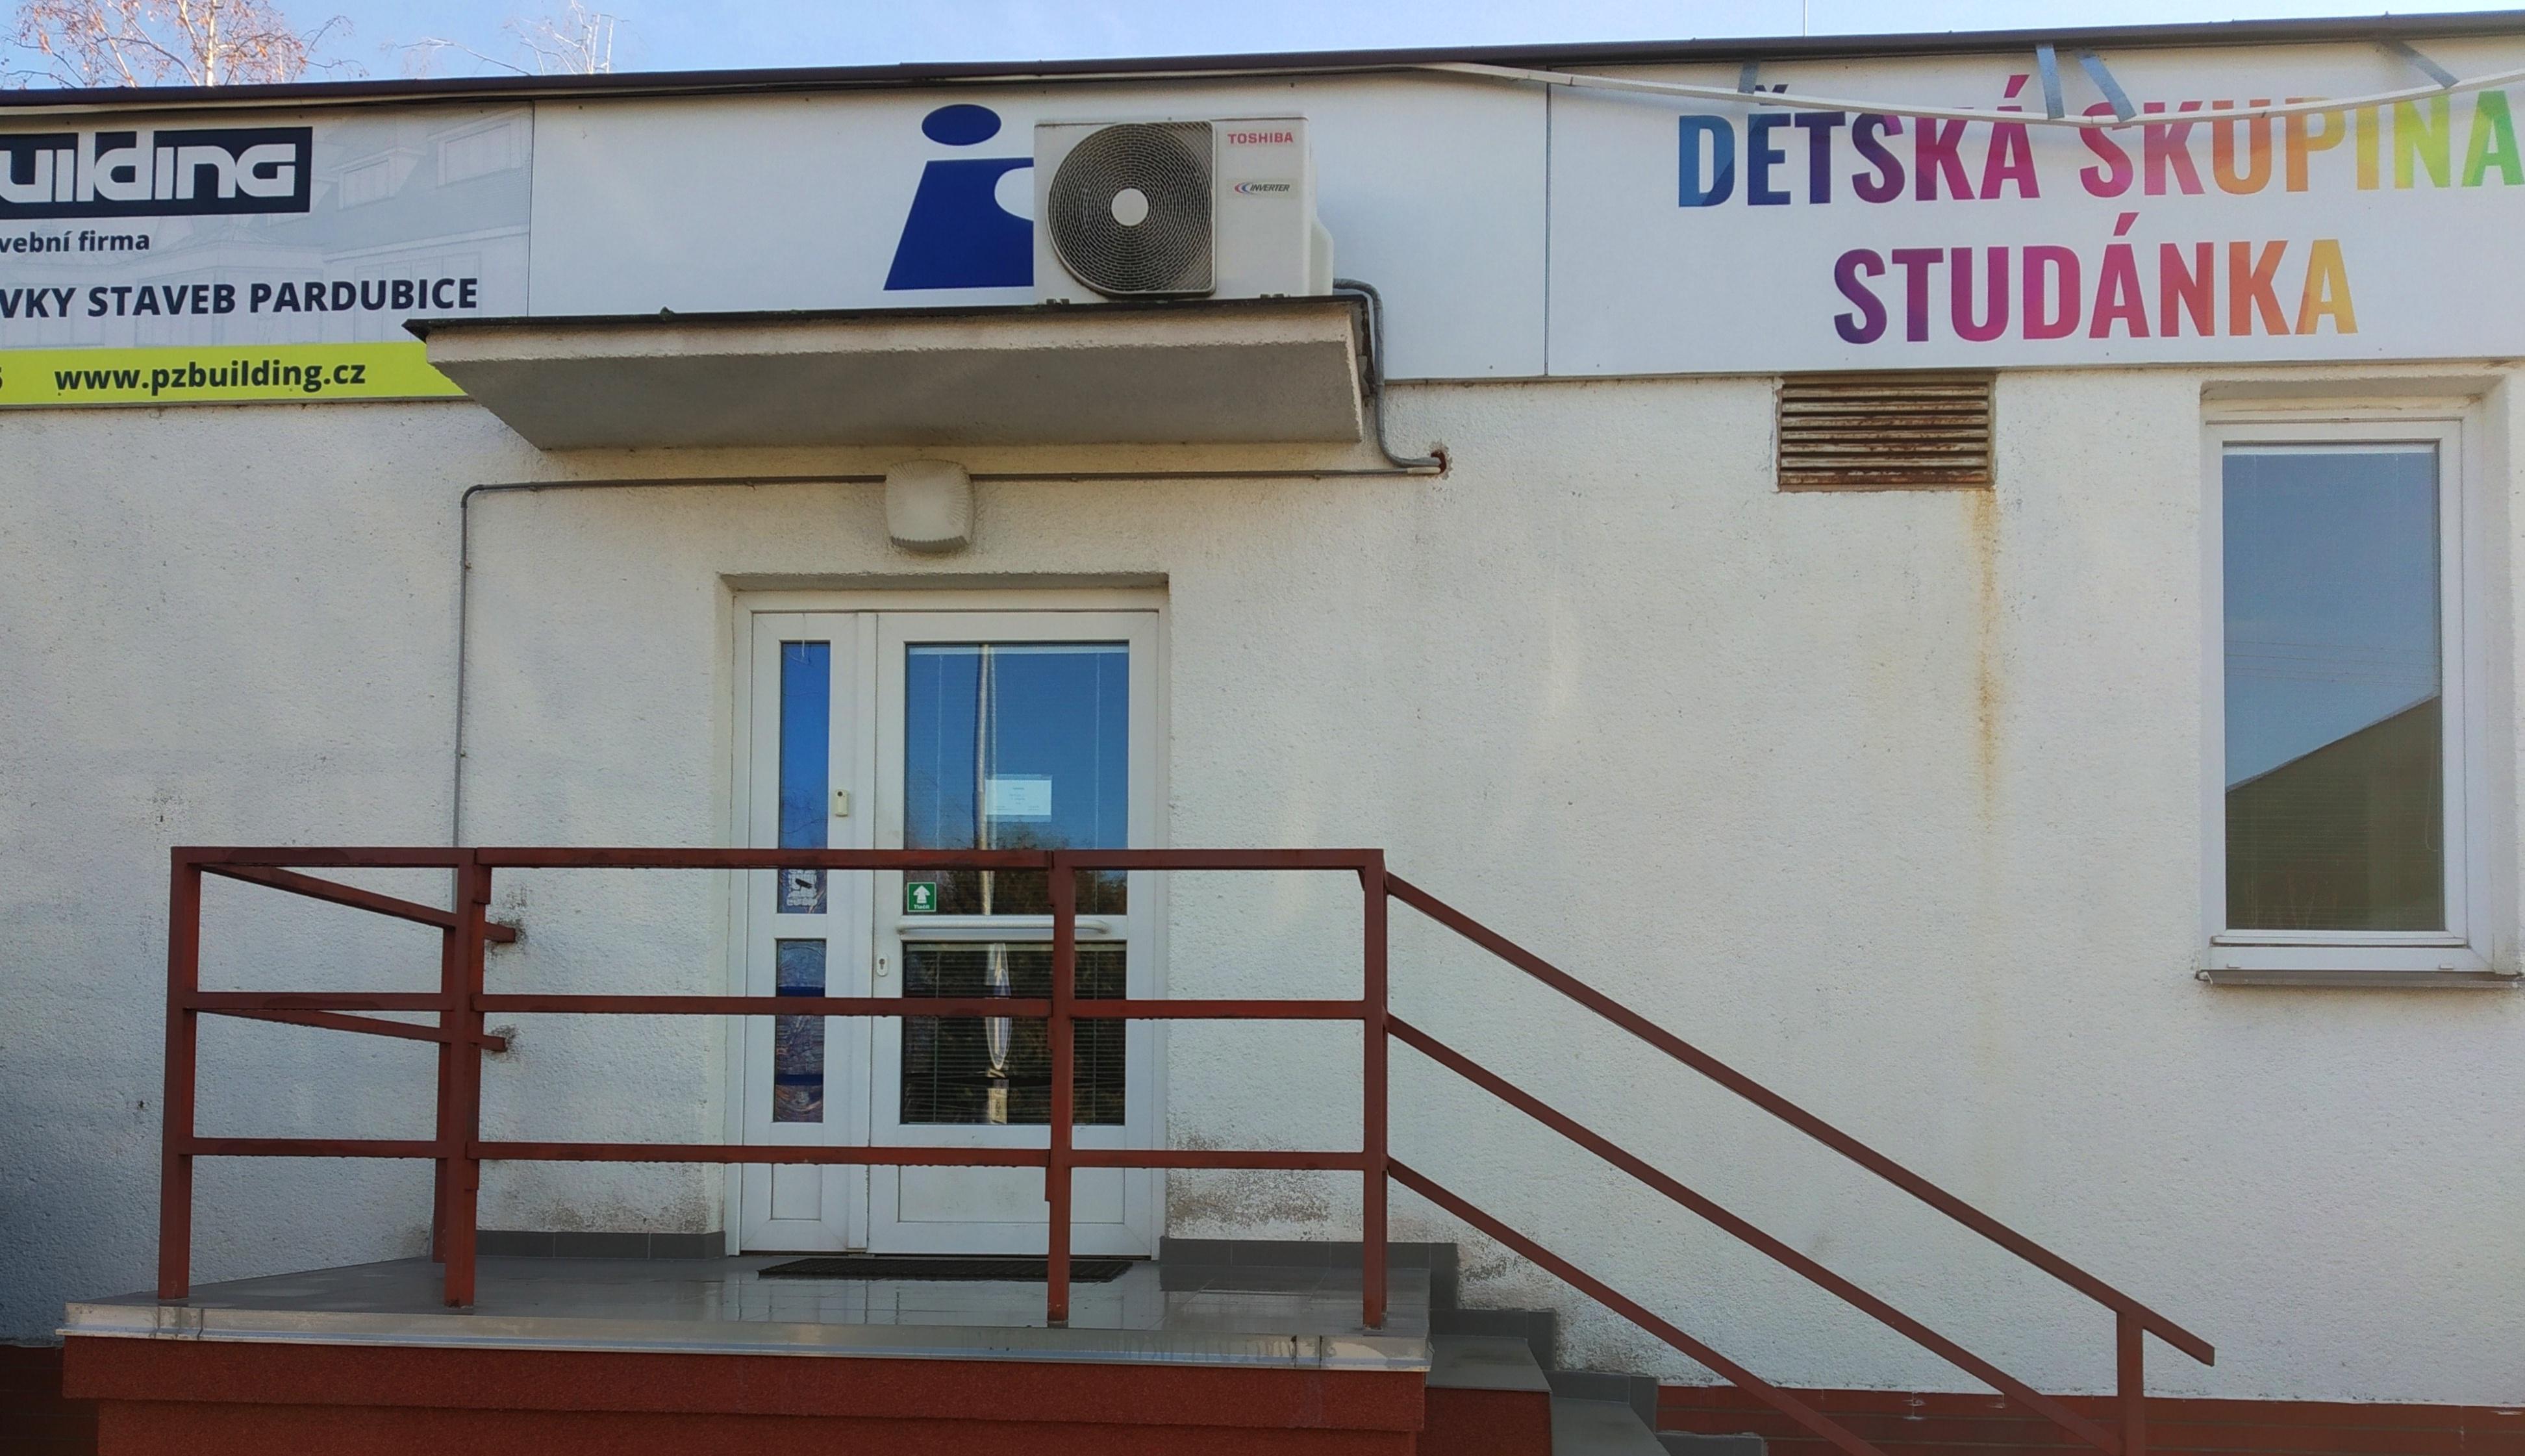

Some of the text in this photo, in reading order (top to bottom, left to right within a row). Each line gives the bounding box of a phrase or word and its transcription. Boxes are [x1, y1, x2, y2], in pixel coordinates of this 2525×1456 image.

[1227, 132, 1294, 144] TOSHIBA
[1678, 74, 2524, 207] DĚTSKÁ SKUPINA
[0, 230, 149, 253] vební firma
[1834, 212, 2358, 344] STUDÁNKA
[0, 278, 478, 318] VKY STAVEB PARDUBICE
[55, 359, 366, 397] www.pzbuilding.cz
